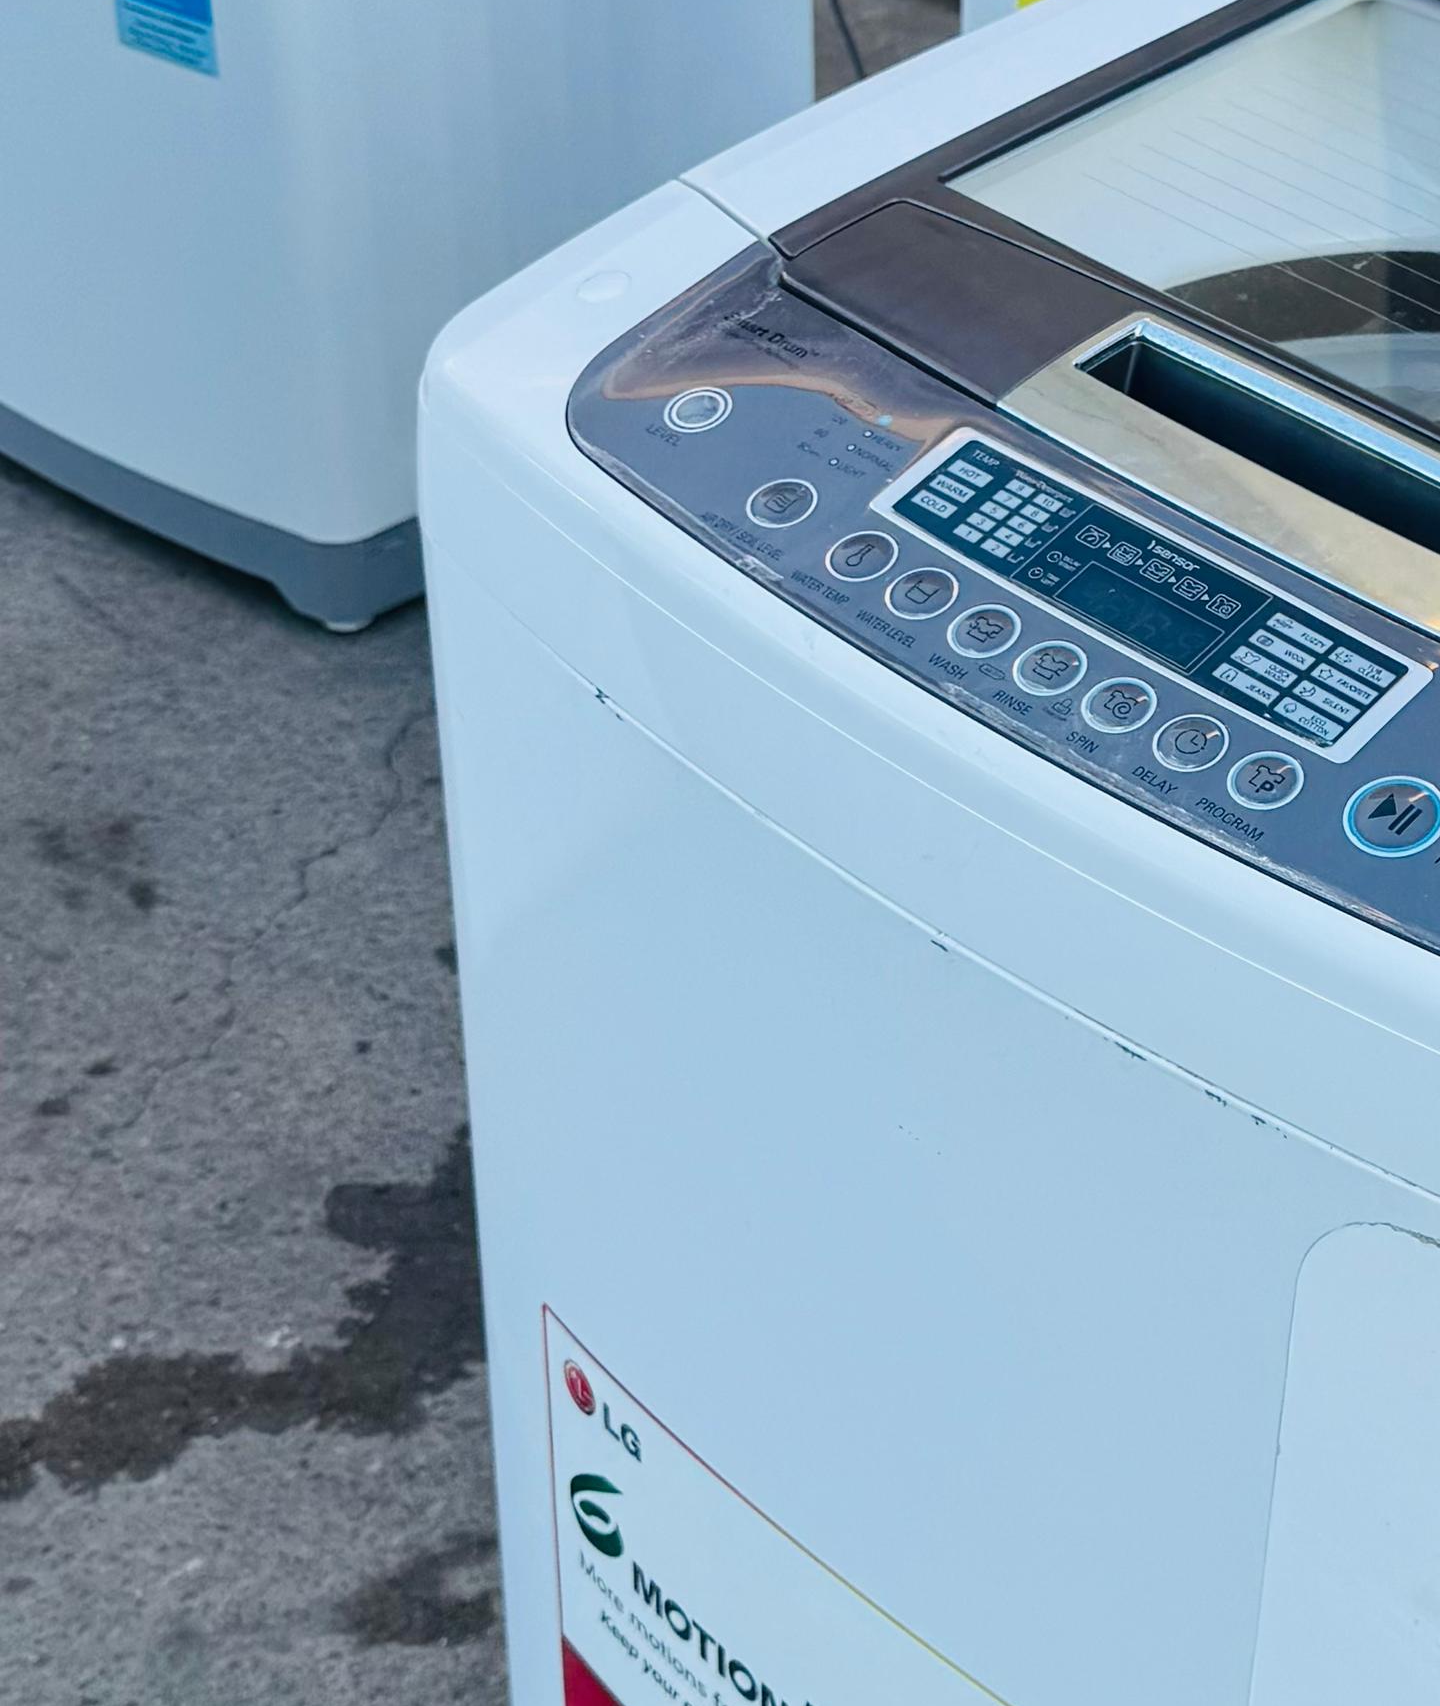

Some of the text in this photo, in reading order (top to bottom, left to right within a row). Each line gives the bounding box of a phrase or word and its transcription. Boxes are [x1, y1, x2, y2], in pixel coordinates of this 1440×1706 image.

[645, 423, 683, 447] LEVEL
[958, 465, 981, 481] HOT
[936, 479, 970, 499] WARM
[920, 495, 948, 514] COLD
[790, 569, 851, 606] WATER TEMP
[856, 609, 917, 649] WATER LEVEL
[928, 653, 969, 681] WASH
[992, 690, 1033, 716] RINSE
[1065, 730, 1099, 755] SPIN
[1131, 765, 1179, 795] DELAY
[1195, 796, 1265, 843] PROGRAM
[602, 1401, 642, 1463] LG
[579, 1549, 625, 1615] More
[630, 1612, 708, 1699] motions
[600, 1609, 640, 1661] Keep
[642, 1658, 681, 1701] your
